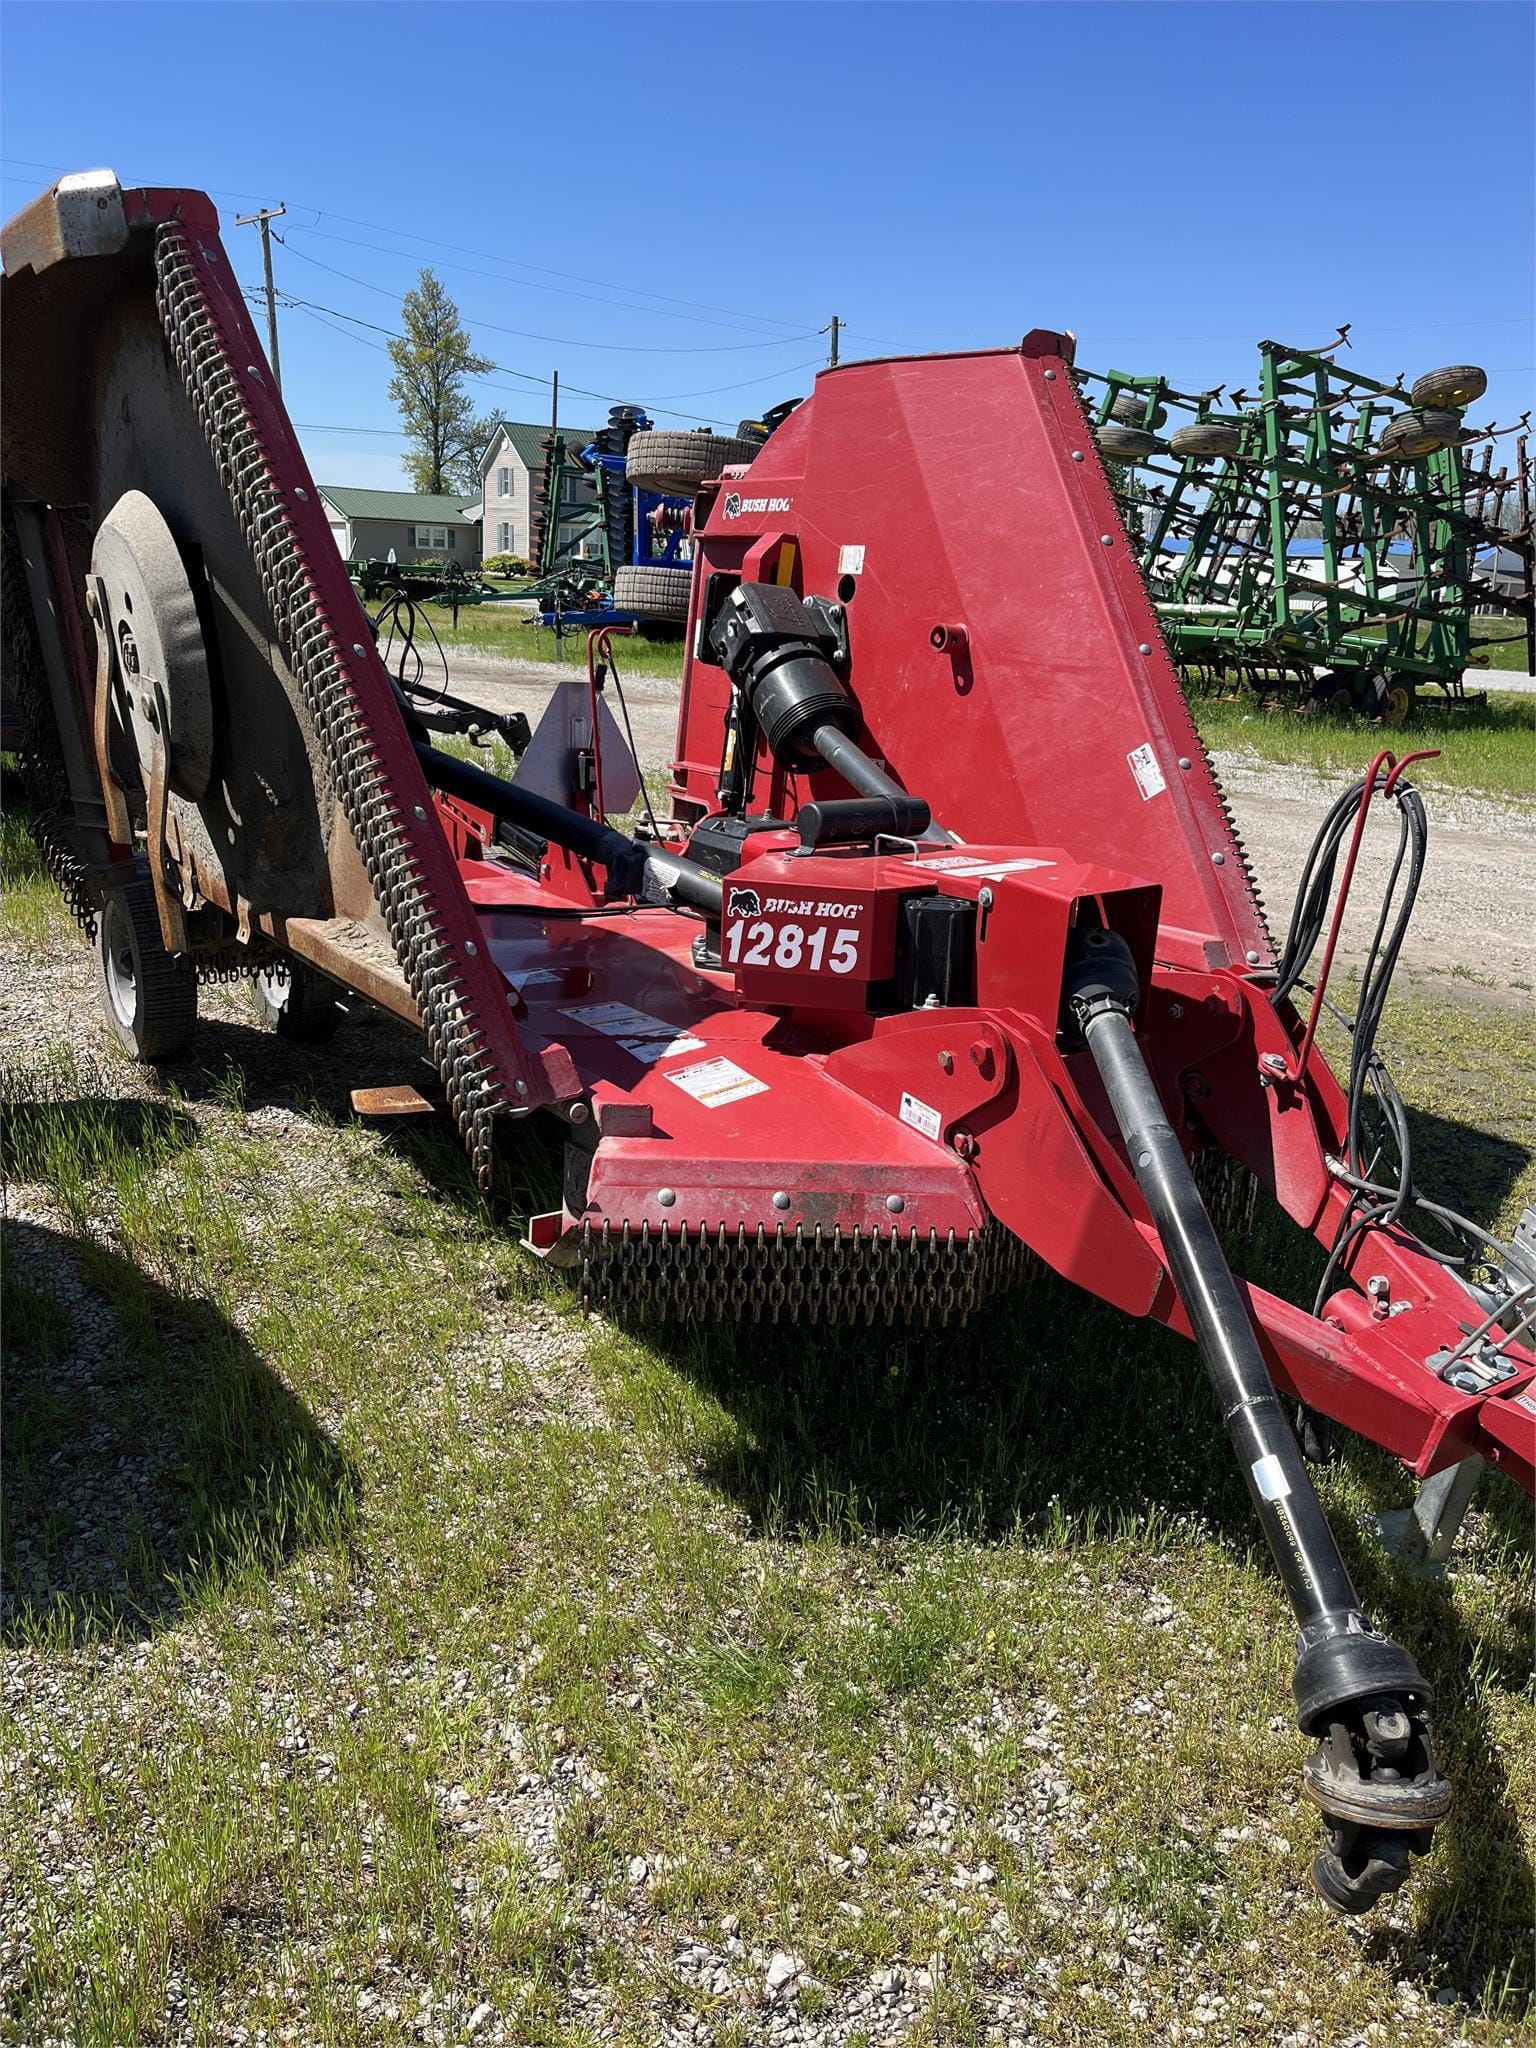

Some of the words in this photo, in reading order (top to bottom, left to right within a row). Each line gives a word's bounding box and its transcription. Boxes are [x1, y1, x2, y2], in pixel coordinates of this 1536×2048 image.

[741, 499, 768, 512] BUSH
[767, 498, 789, 512] HOG
[763, 898, 814, 916] BUSH
[815, 902, 858, 919] HOG
[726, 919, 860, 974] 12815
